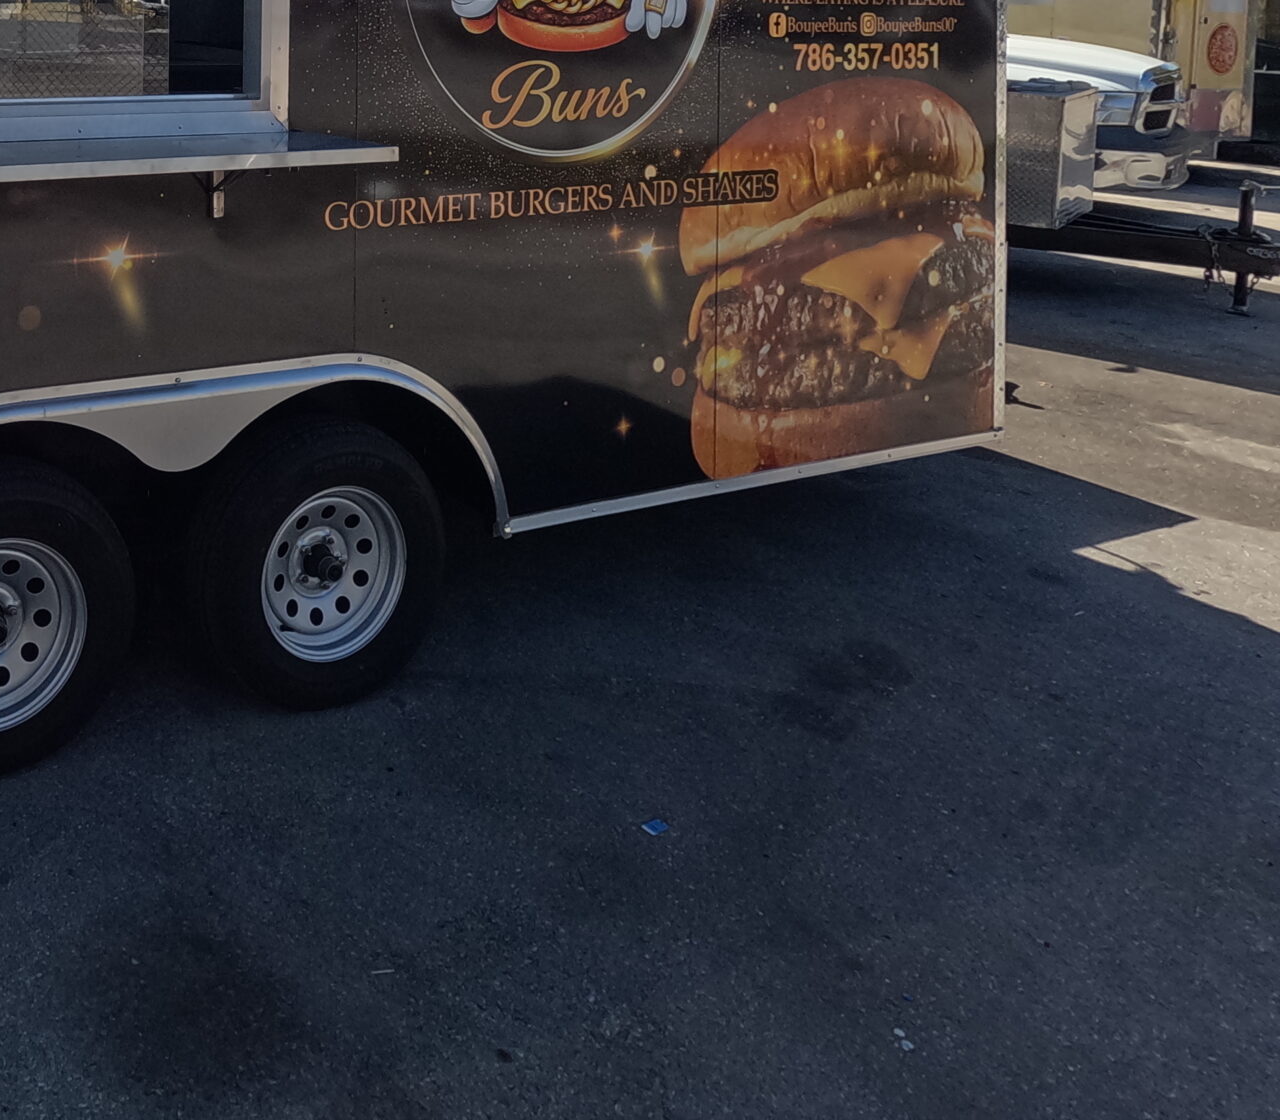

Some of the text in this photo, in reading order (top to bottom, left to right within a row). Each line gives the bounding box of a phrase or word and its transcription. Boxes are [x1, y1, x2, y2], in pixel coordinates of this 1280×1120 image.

[788, 17, 858, 37] BoujeeBuns
[793, 42, 939, 71] 786-357-0351
[482, 60, 646, 129] Buns
[324, 173, 777, 231] GOURMET BURGERS AND SHAKES
